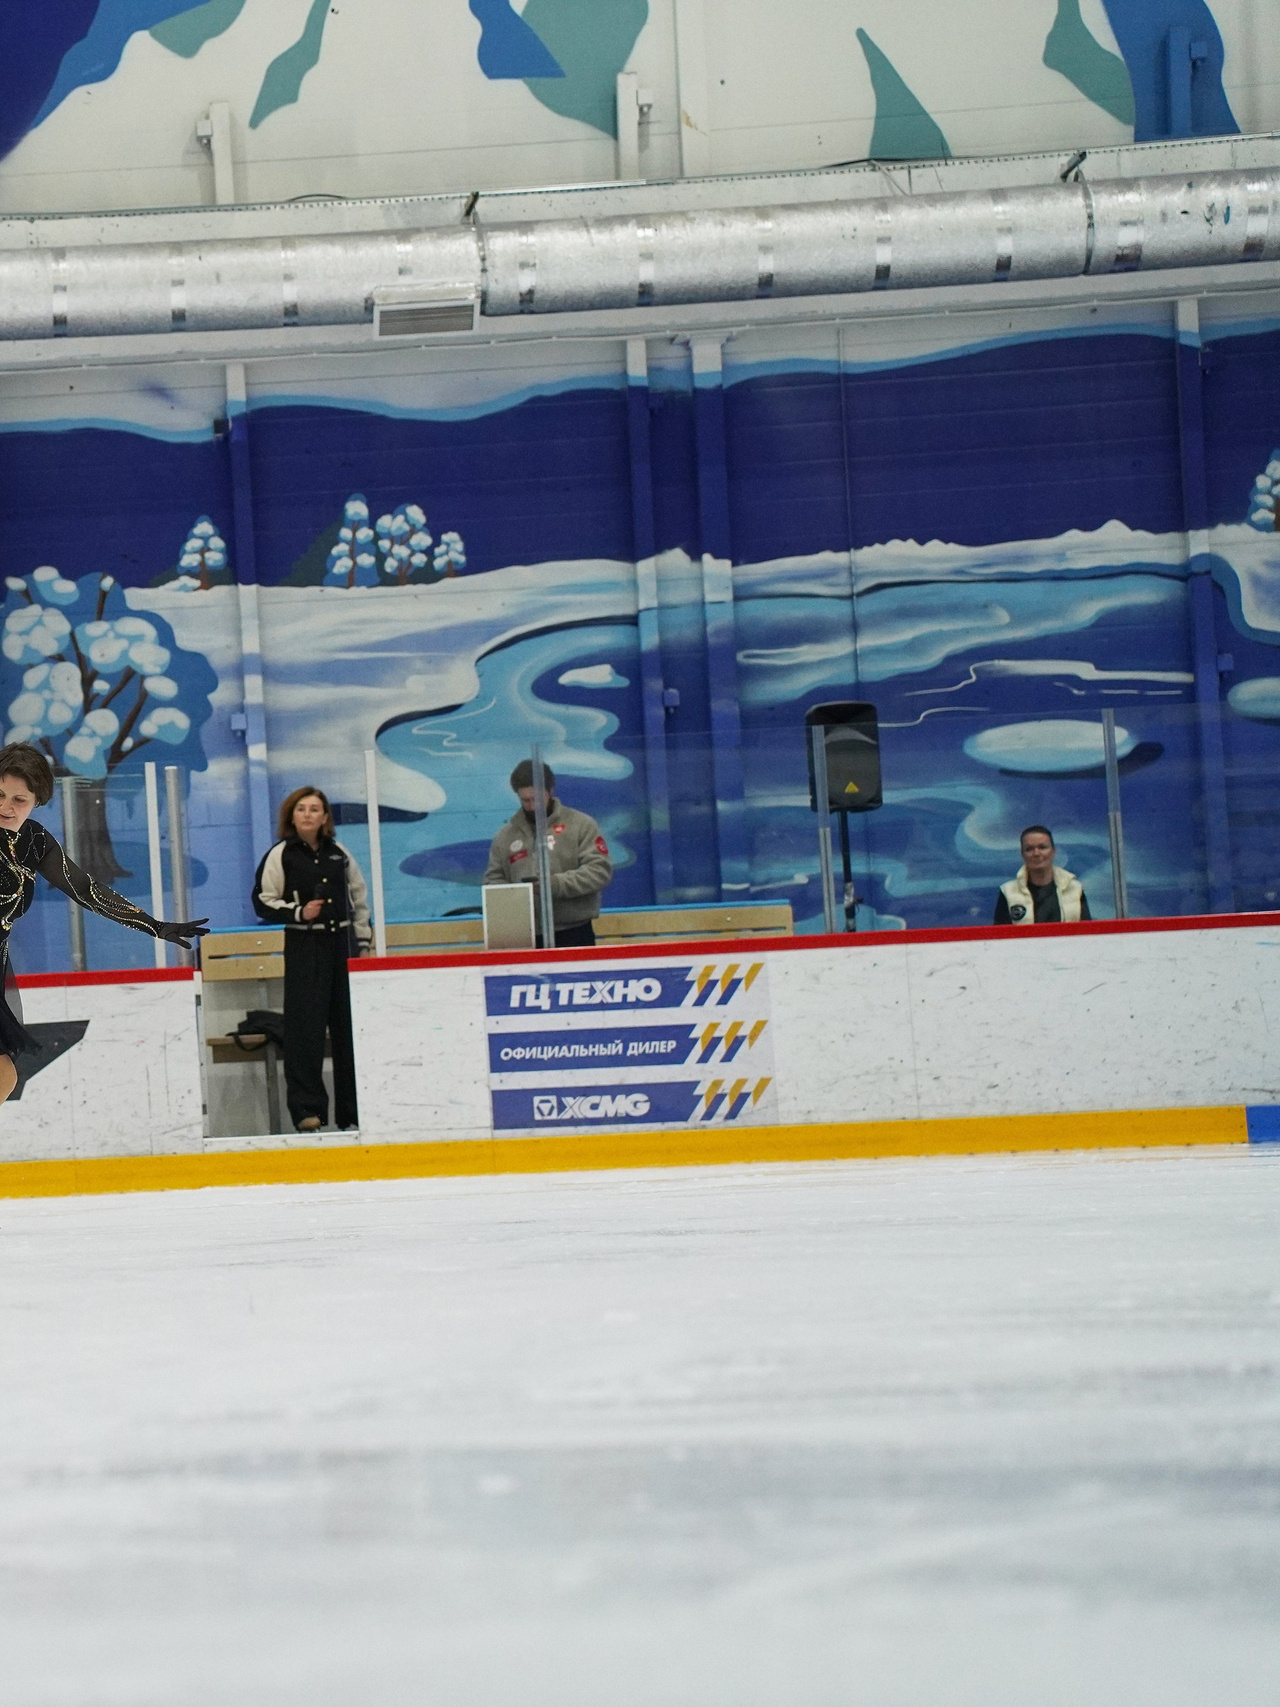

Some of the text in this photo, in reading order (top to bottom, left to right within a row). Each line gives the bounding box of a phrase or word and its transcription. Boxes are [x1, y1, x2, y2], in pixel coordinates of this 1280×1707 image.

[510, 977, 662, 1011] ГЦ ТЕХНО
[500, 1039, 677, 1061] ОФИЦИАЛЬНЫЙ ДИЛЕР
[559, 1092, 651, 1119] XCMG
